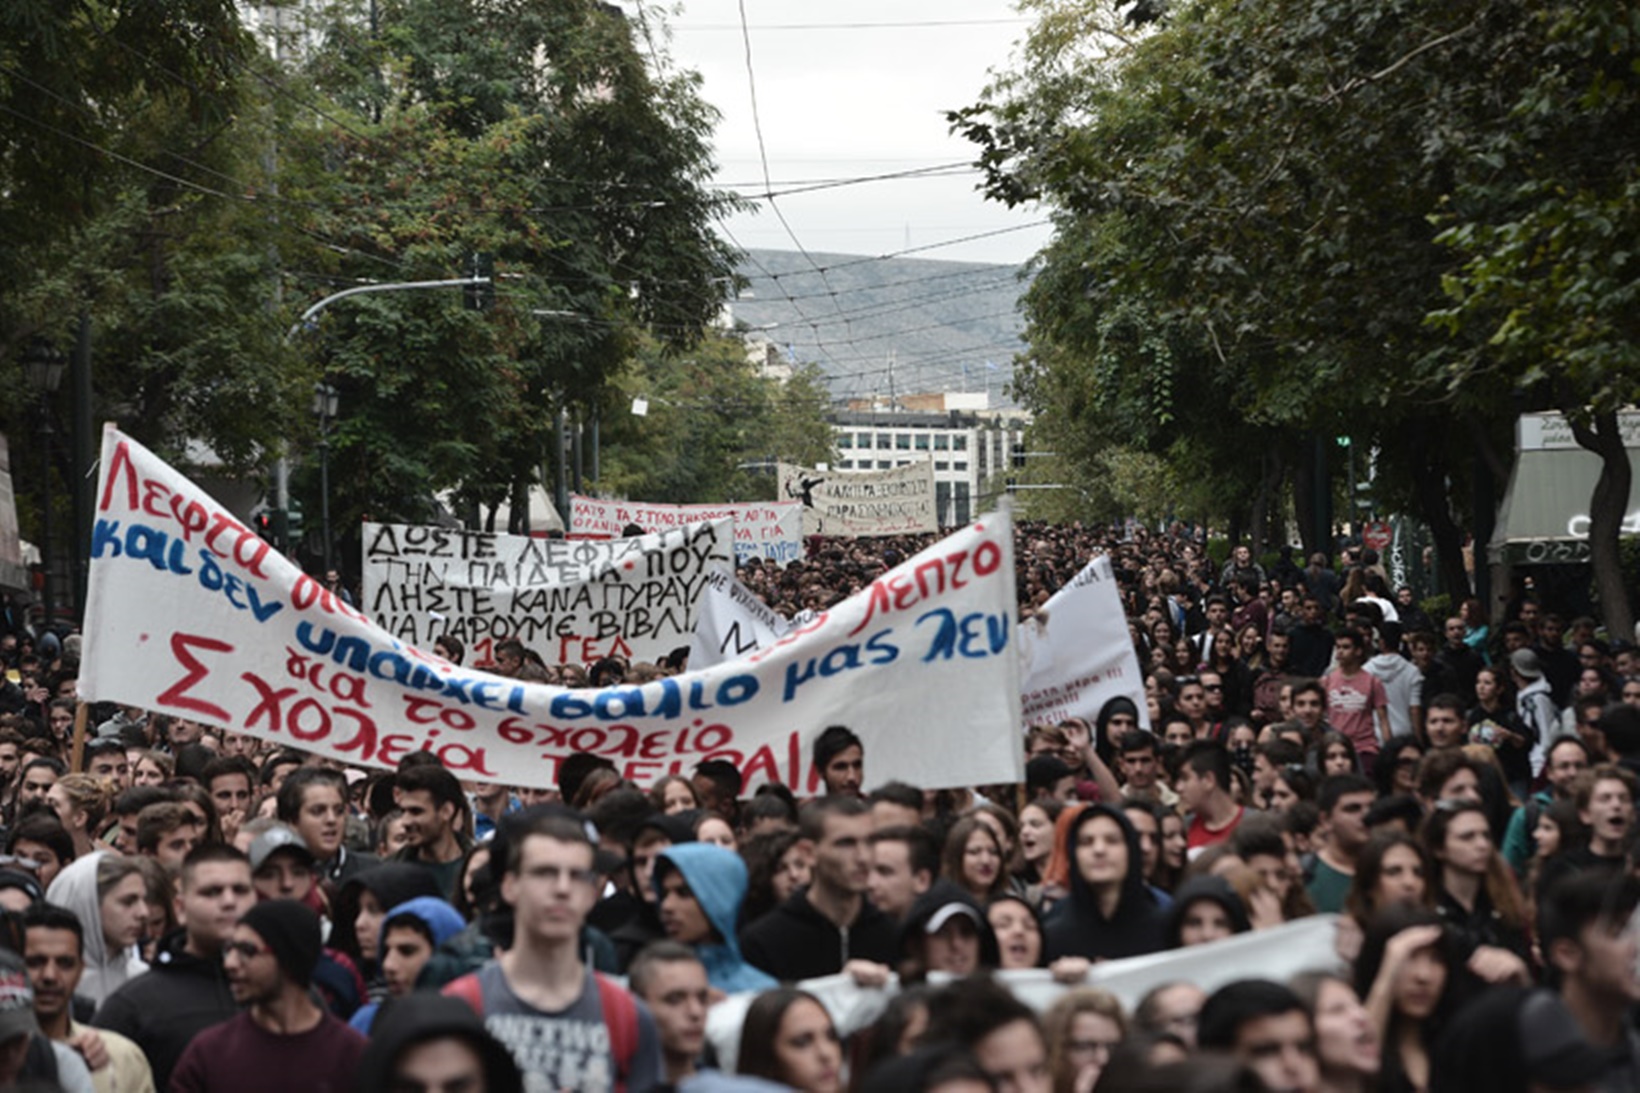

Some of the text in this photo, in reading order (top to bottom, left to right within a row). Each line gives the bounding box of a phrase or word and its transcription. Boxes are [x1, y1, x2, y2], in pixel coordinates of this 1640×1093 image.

[615, 508, 631, 521] ΤΑ
[368, 525, 498, 560] ΔΩΣΤΕ
[518, 537, 645, 568] ΛΕΦΤΑ
[371, 557, 448, 587] ΤΗΝ
[91, 518, 193, 575] και
[198, 549, 285, 623] δεν
[783, 628, 900, 703] μας
[914, 607, 1009, 663] λεν
[373, 581, 497, 614] ΛΗΣΤΕ
[376, 614, 418, 645] ΝΑ
[590, 606, 700, 640] ΒΙΒΛΙ
[285, 646, 373, 709] για
[402, 693, 476, 731] το
